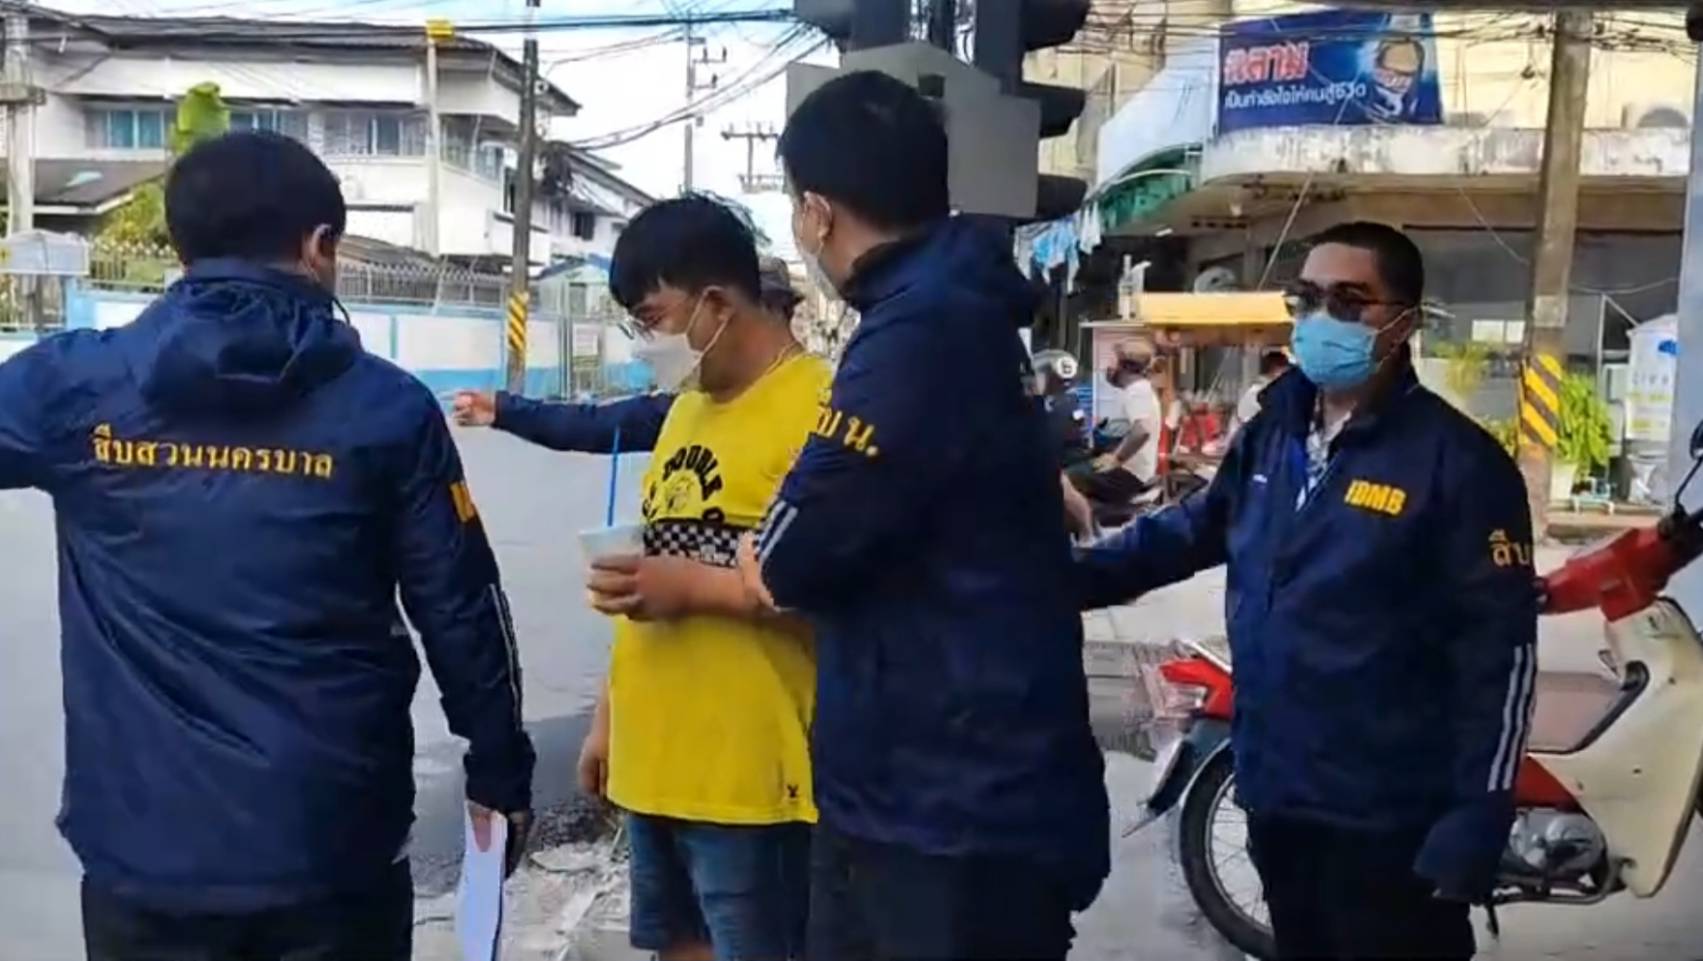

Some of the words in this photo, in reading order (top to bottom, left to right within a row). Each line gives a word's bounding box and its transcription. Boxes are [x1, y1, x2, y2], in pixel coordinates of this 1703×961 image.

[92, 424, 334, 479] สืบสวนนครบาล
[1344, 479, 1407, 516] IDMB
